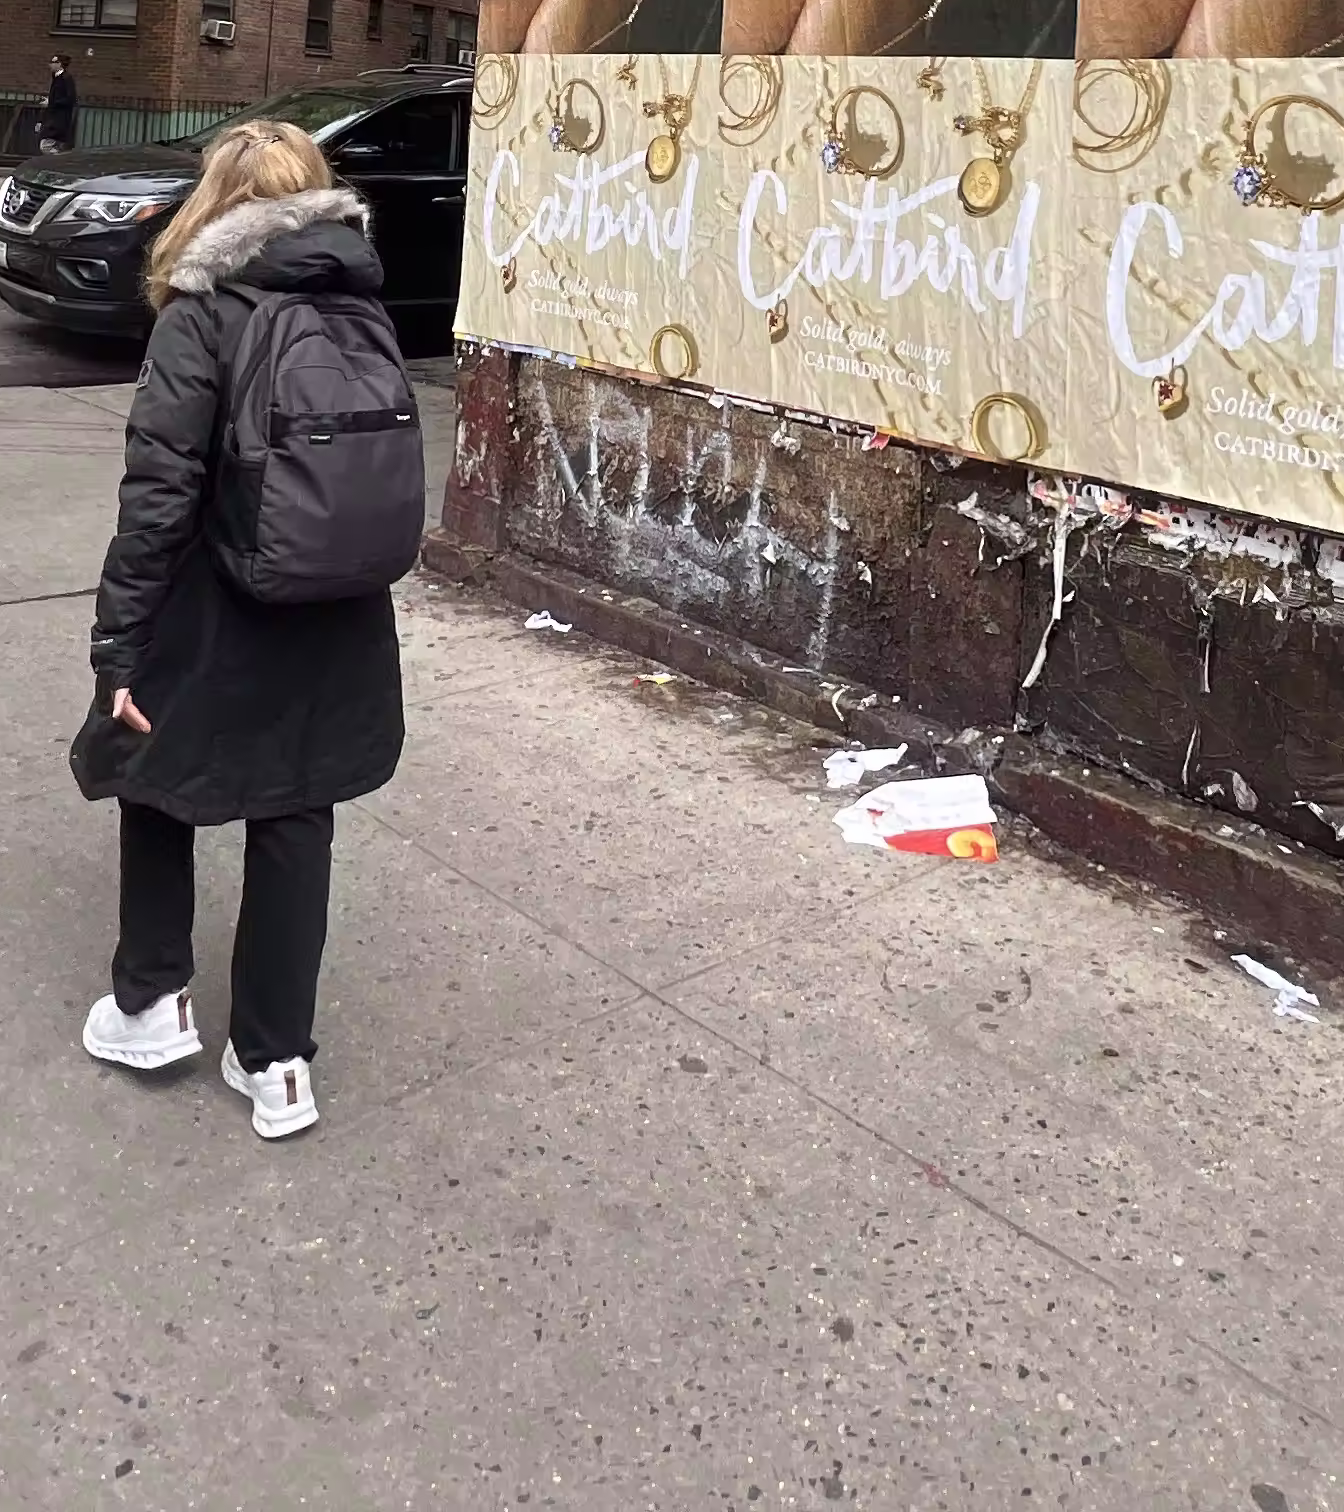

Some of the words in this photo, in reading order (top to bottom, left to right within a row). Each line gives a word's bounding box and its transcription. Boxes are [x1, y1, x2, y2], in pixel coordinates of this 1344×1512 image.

[484, 149, 700, 279] Catbird
[737, 168, 1041, 339] Catbird
[800, 315, 845, 344] Solid
[847, 325, 889, 356] gold,
[895, 332, 952, 372] always
[804, 350, 943, 396] CATBIRDNYC.COM
[1207, 386, 1275, 424] Solid
